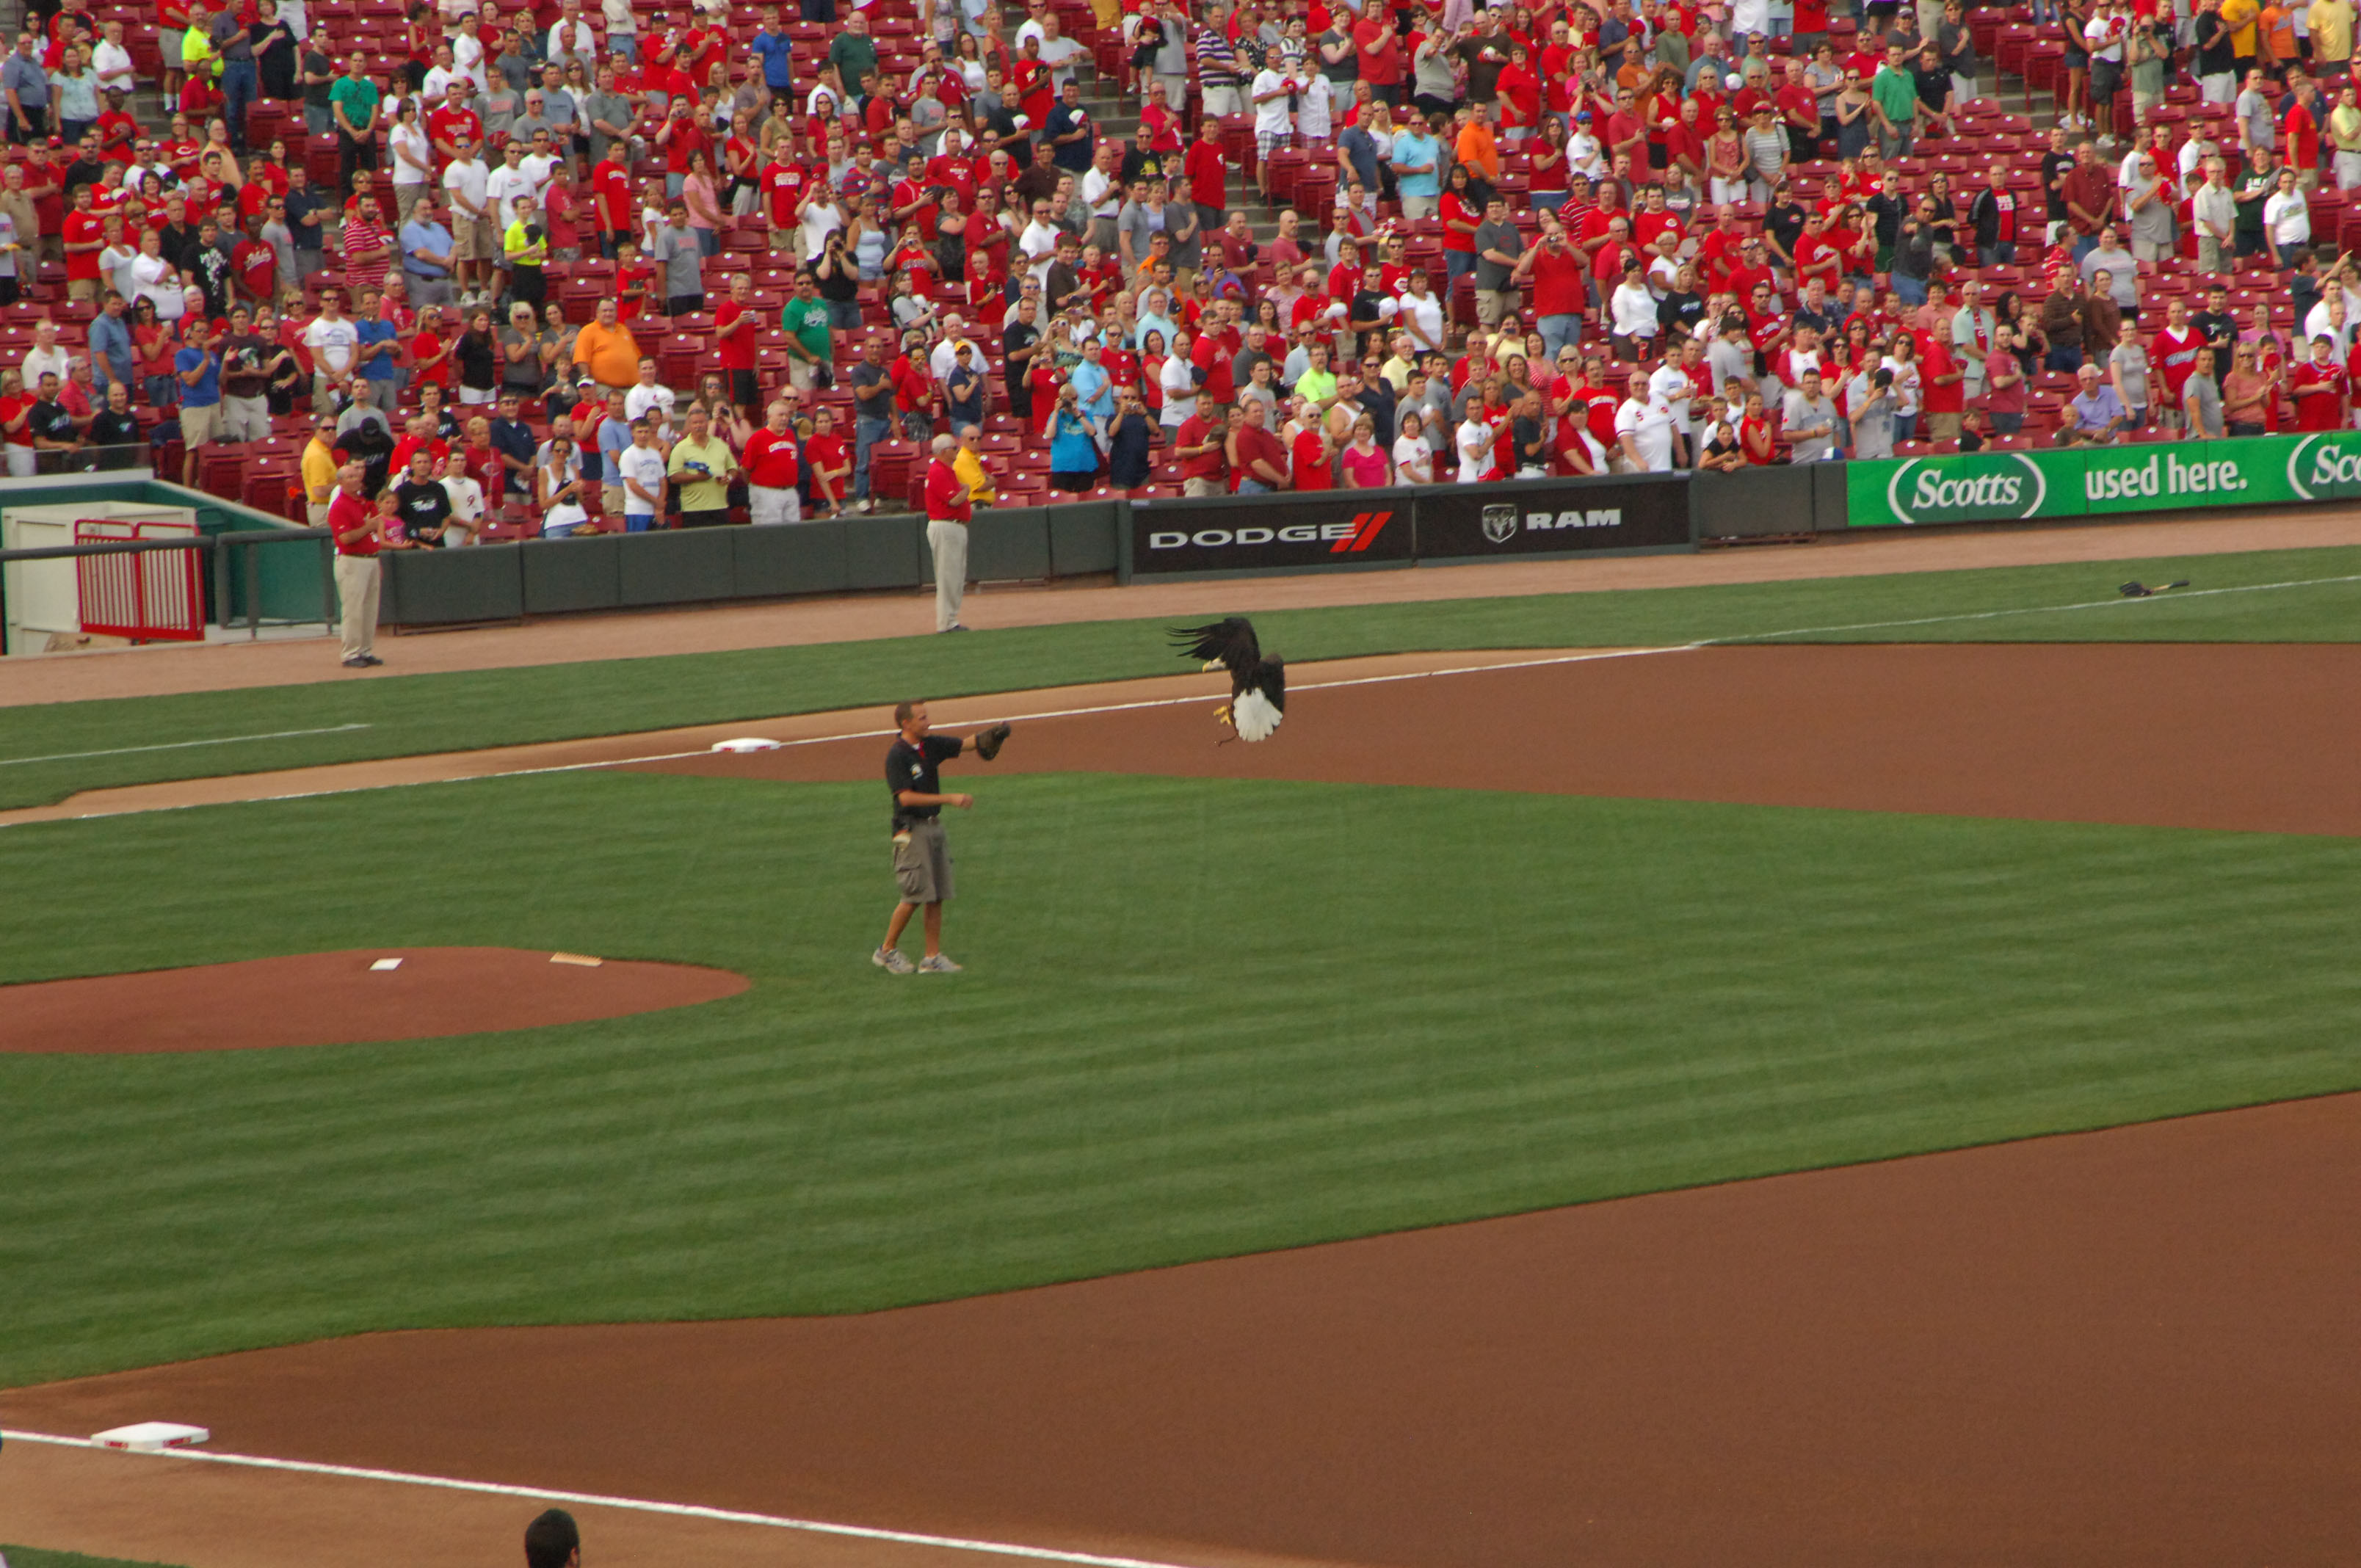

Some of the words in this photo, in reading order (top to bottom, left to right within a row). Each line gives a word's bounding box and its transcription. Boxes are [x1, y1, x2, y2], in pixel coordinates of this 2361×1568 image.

[1912, 468, 2022, 509] Scotts
[2086, 454, 2159, 500] used
[2167, 453, 2248, 493] here.
[1150, 523, 1357, 548] DODGE
[1526, 509, 1621, 530] RAM
